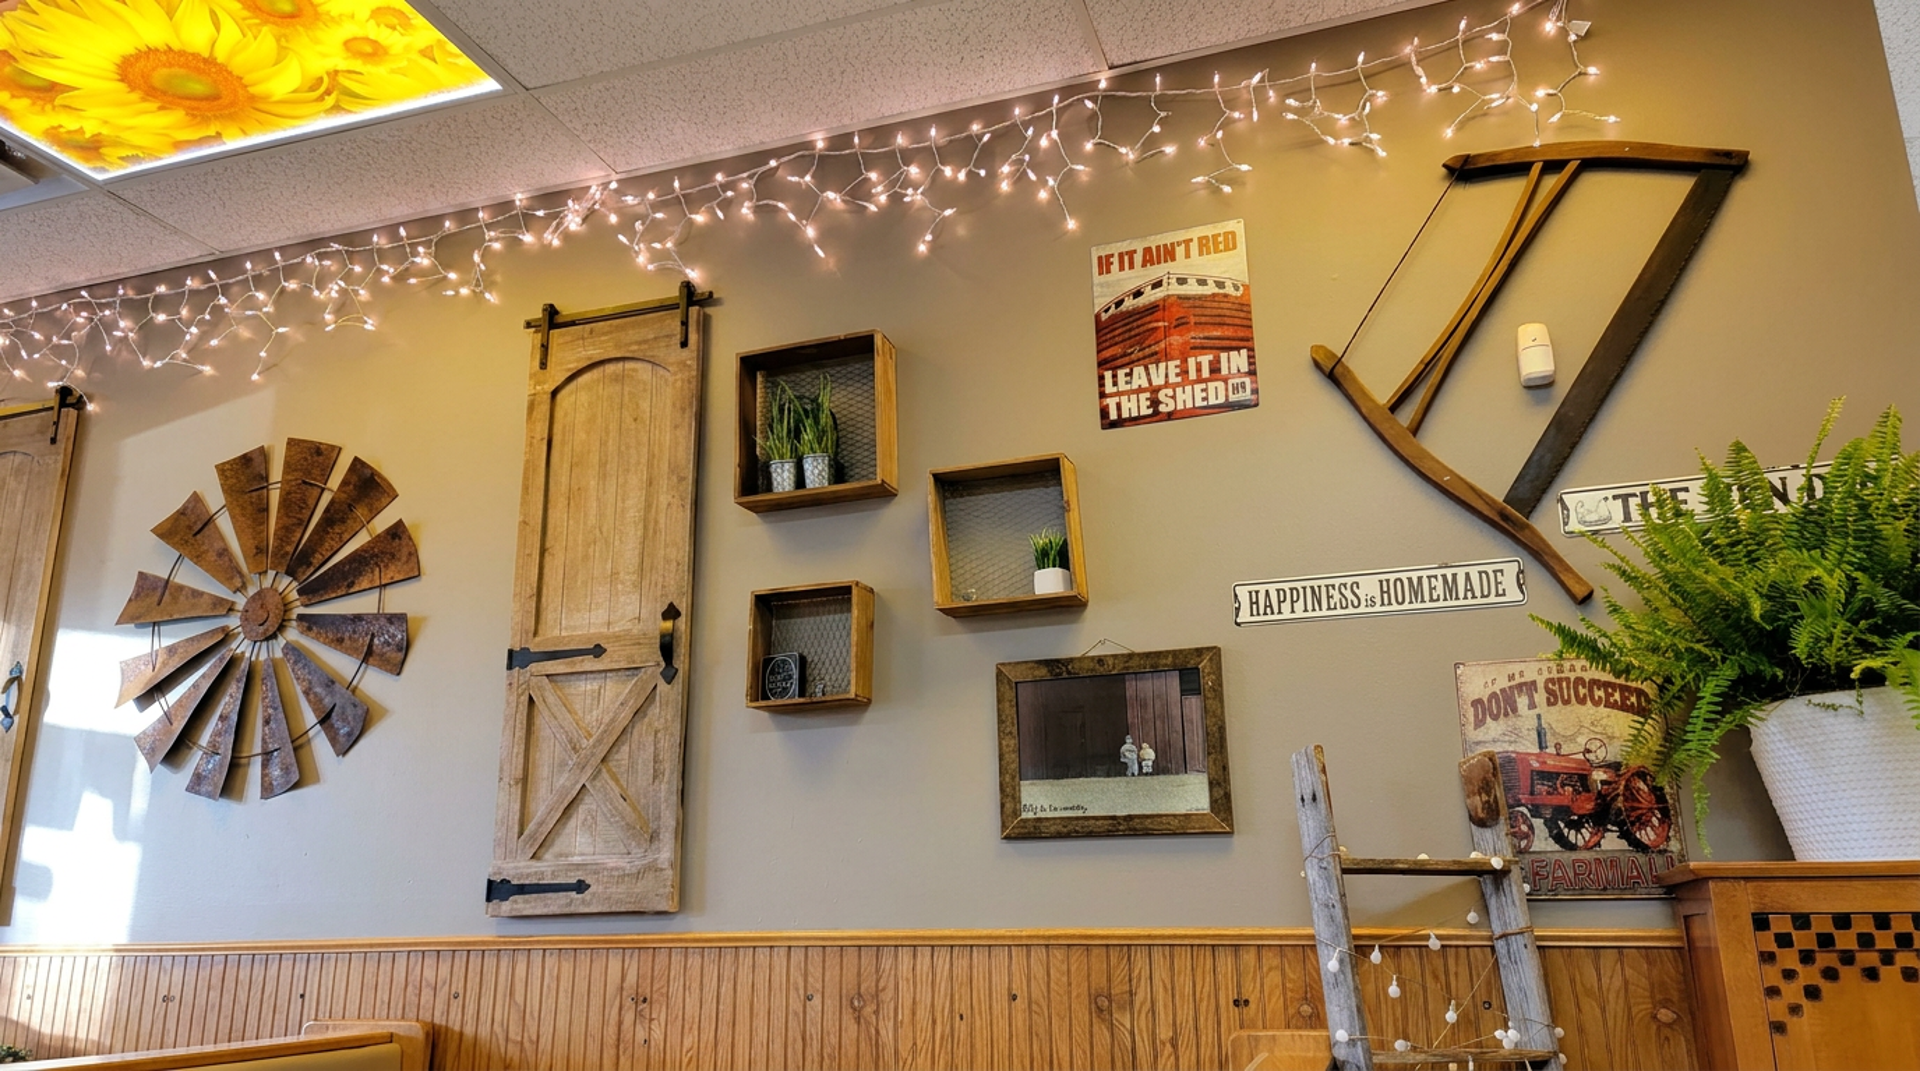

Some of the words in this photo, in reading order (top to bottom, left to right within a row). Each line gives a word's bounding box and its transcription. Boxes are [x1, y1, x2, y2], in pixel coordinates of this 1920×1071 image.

[1097, 253, 1115, 276] IF
[1117, 249, 1138, 273] IT
[1140, 238, 1194, 268] AIN'T
[1197, 230, 1238, 257] RED
[1104, 359, 1182, 394] LEAVE
[1187, 354, 1214, 380] IT
[1219, 348, 1250, 375] IN
[1104, 392, 1154, 421] THE
[1158, 380, 1226, 413] SHED
[1247, 581, 1363, 617] HAPPINESS
[1364, 594, 1377, 607] is
[1378, 568, 1507, 607] HOMEMADE
[1470, 679, 1539, 731] DON'T
[1543, 676, 1653, 718] SUCCEED
